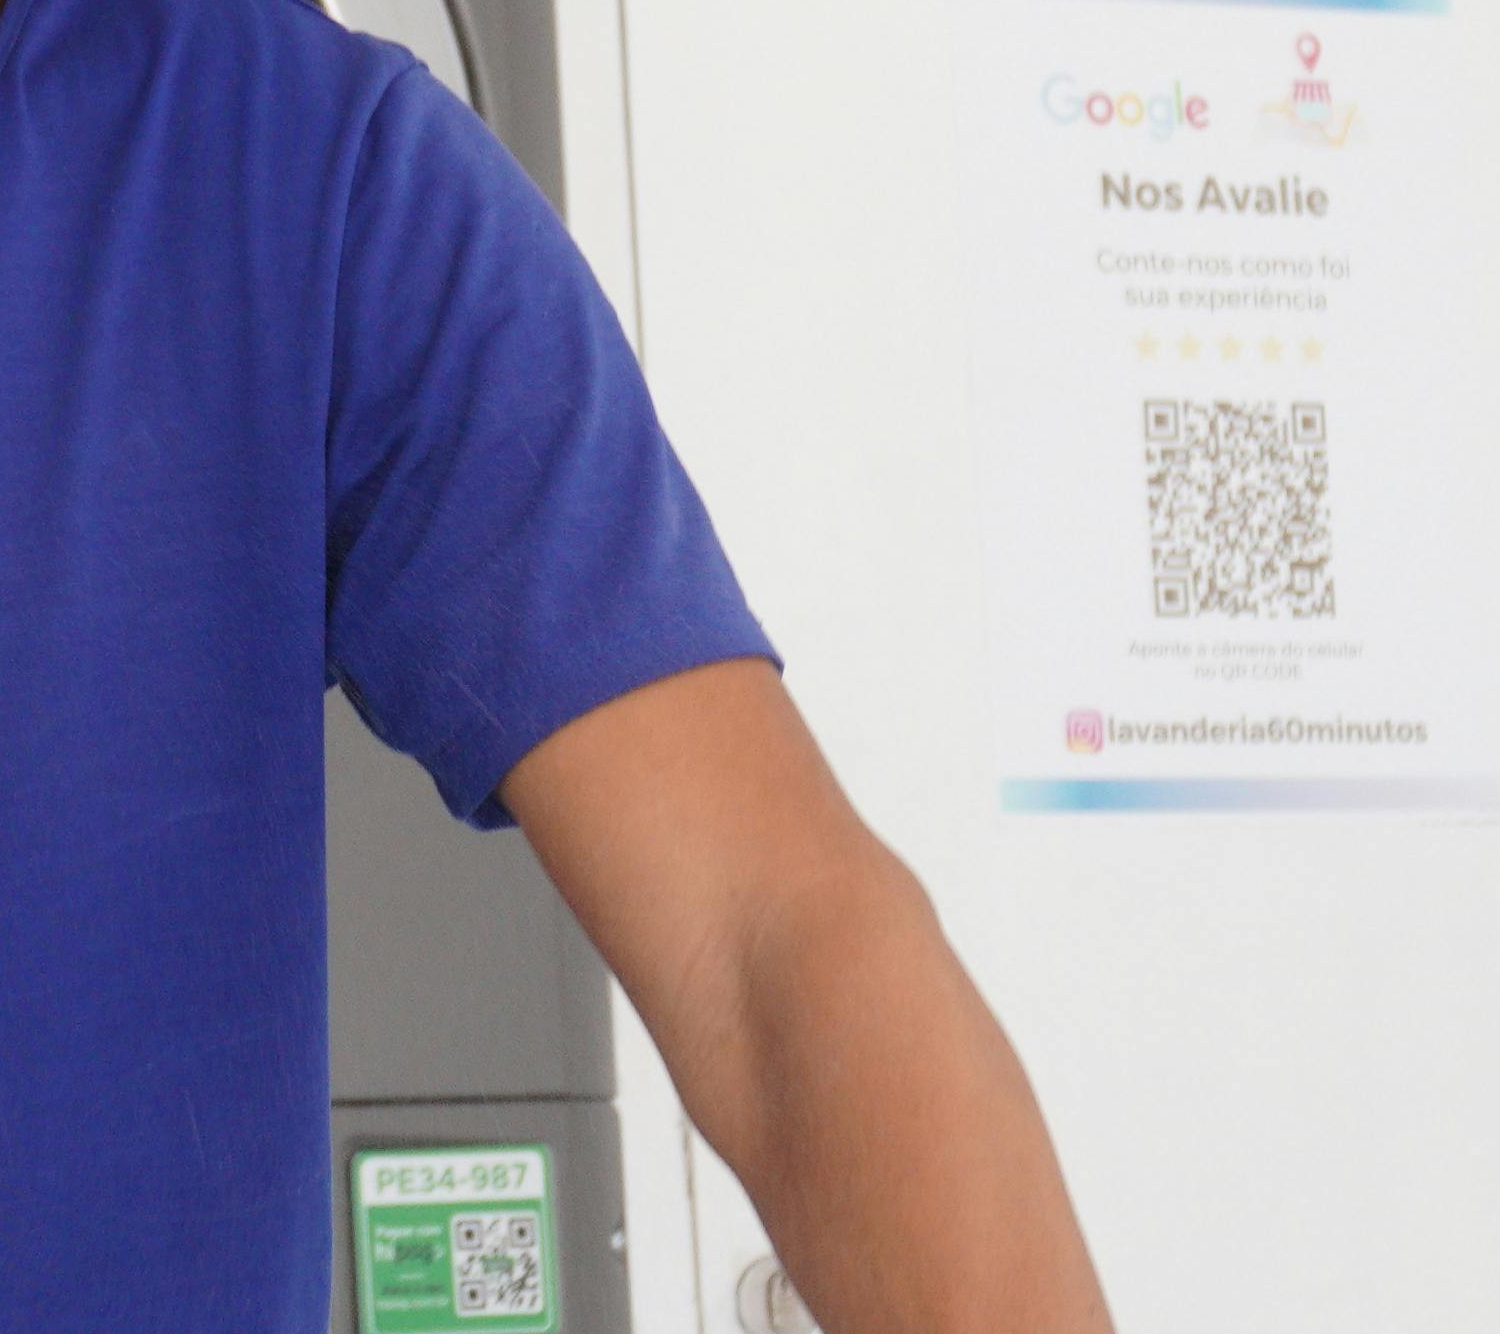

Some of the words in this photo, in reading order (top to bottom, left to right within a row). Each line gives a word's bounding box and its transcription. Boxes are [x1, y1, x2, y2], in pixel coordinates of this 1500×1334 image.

[1041, 73, 1211, 142] Google
[1099, 172, 1184, 212] Nos
[1195, 175, 1330, 217] Avalie
[1240, 254, 1313, 278] como
[1319, 250, 1352, 280] foi
[1123, 285, 1170, 307] sua
[1107, 715, 1430, 747] lavanderia60minutos
[377, 1162, 528, 1195] PE34-987
